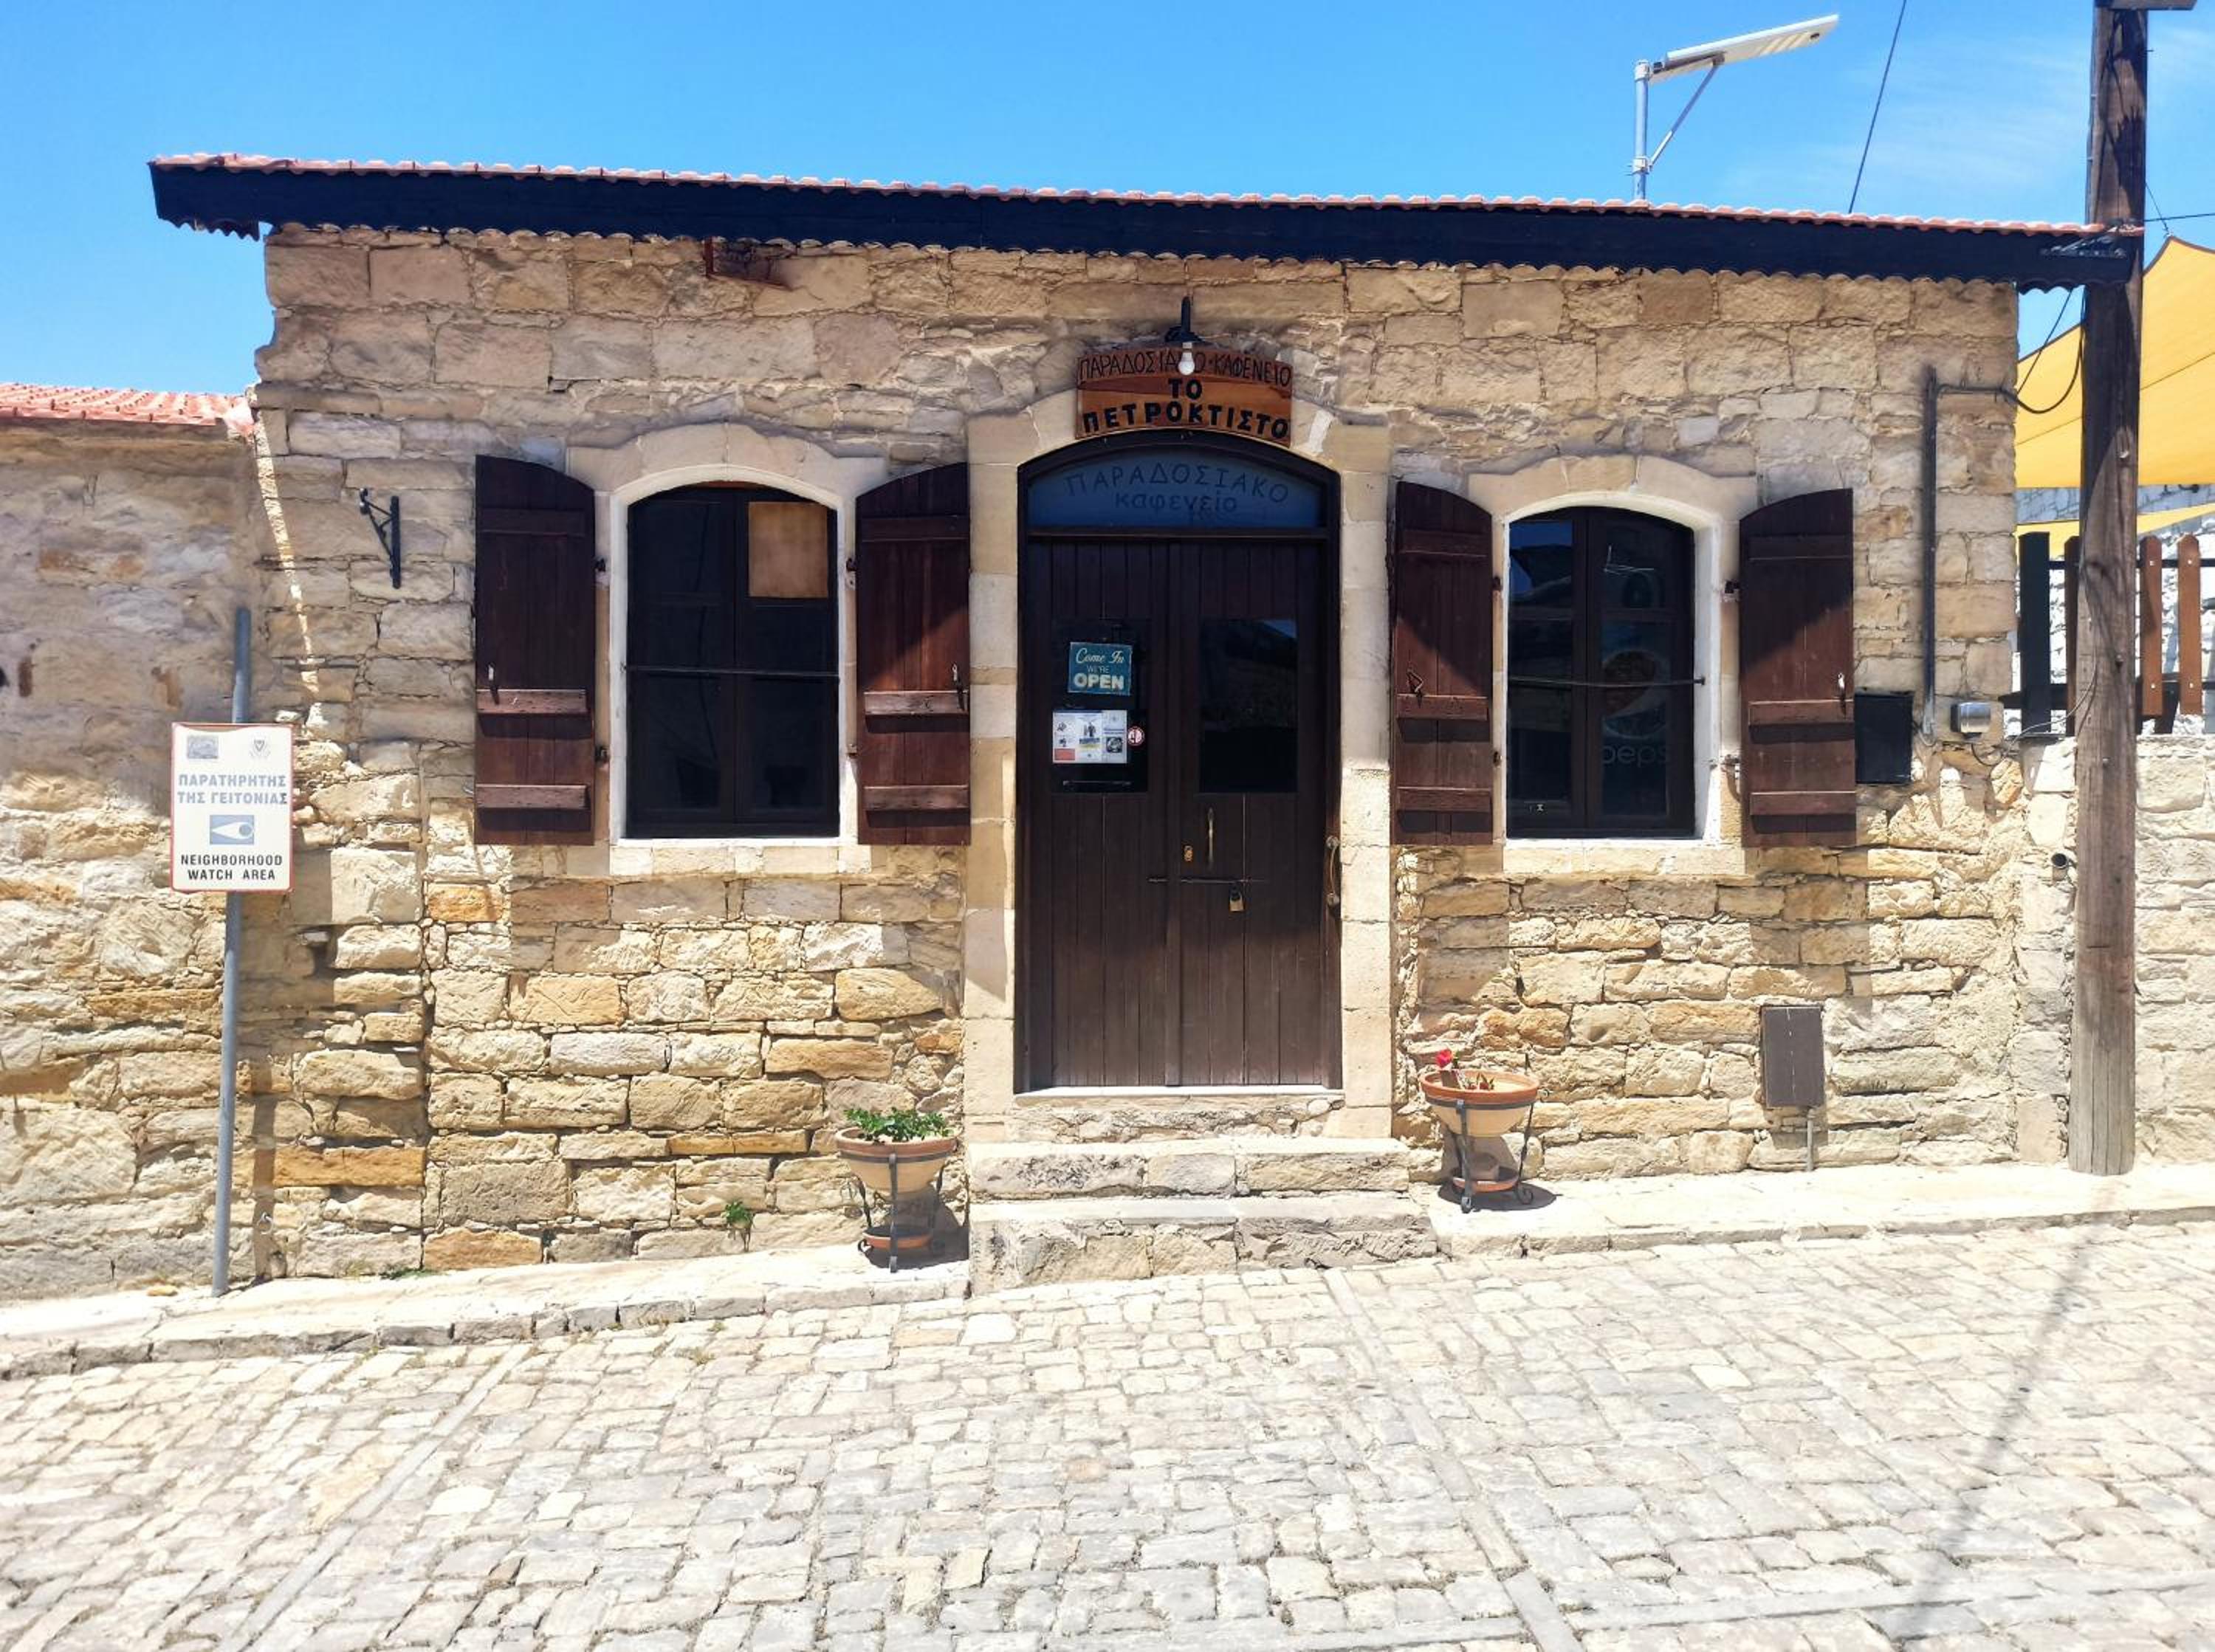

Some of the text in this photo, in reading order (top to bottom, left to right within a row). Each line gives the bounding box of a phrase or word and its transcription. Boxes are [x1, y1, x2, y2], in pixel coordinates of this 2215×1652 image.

[1079, 349, 1292, 388] ΠΑΡΑΔΟΣΙΑΟ ΚΑΦΕΝΕΙΟ
[1168, 378, 1203, 399] ΤΟ
[1083, 401, 1288, 438] ΠΕΤΡΟΚΤΙΣΤΟ
[1065, 462, 1288, 503] ΠΑΡΑΔΟΣΙΑΚΟ
[1076, 647, 1124, 664] Come In
[1074, 672, 1124, 689] OPEN
[1602, 745, 1669, 768] peps
[179, 774, 286, 787] ΠΑΡΑΤΗΡΗΤΗΣ
[177, 792, 287, 804] ΤΗΣ ΓΕΙΤΟΝΙΑΣ
[181, 854, 283, 866] NEIGHBORHOOD
[188, 869, 275, 881] WATCH AREA
